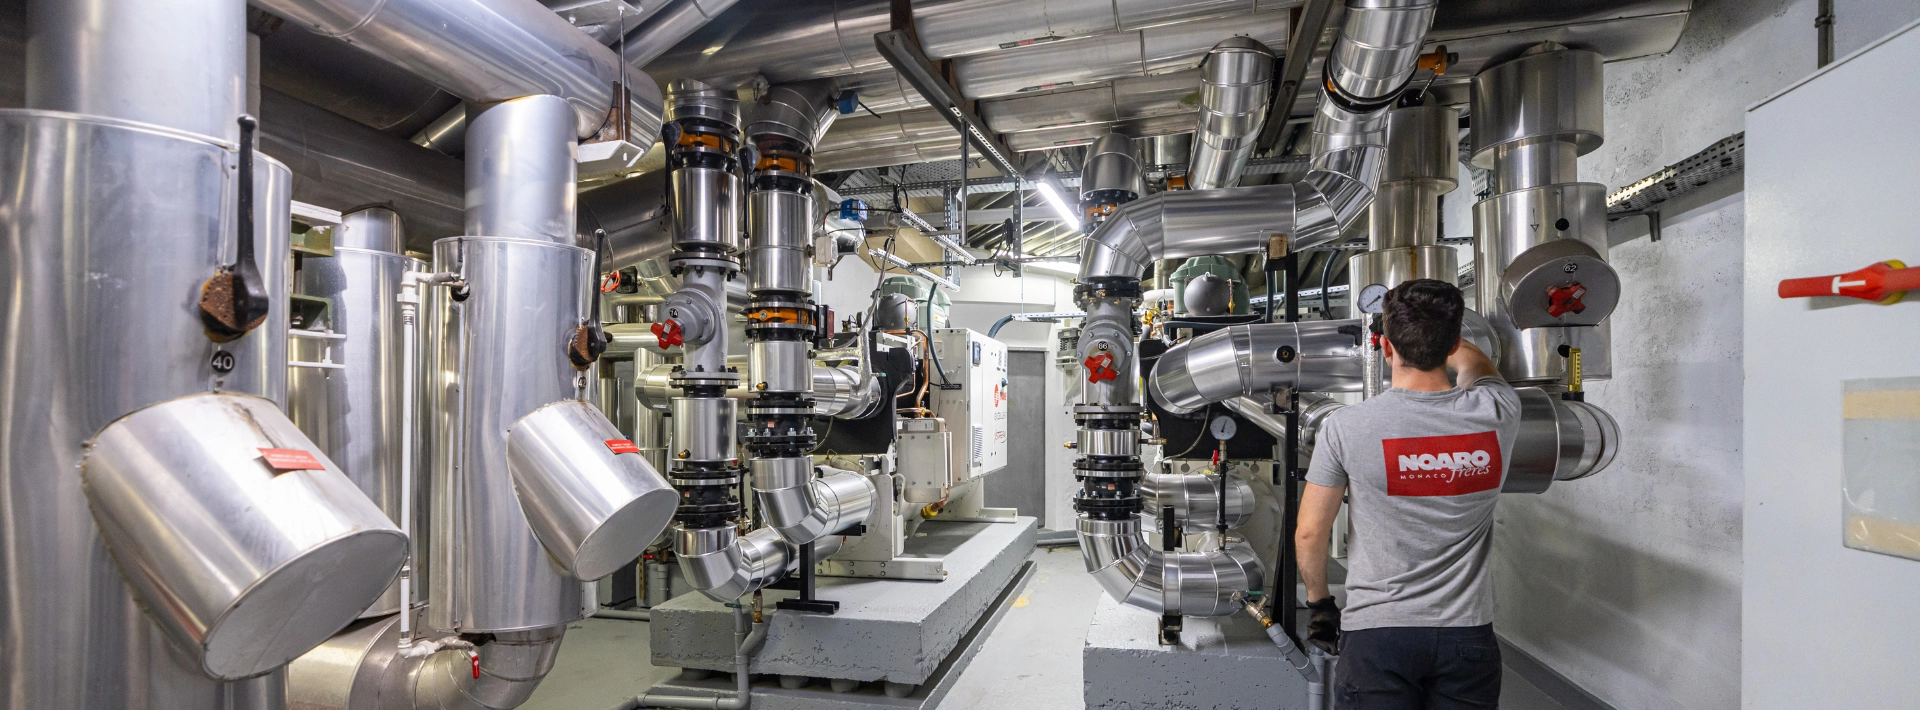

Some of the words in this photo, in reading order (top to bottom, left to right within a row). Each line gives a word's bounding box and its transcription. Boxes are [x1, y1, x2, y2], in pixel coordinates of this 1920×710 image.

[1564, 263, 1577, 272] 62
[212, 355, 234, 370] 40
[1398, 449, 1490, 472] NOARO
